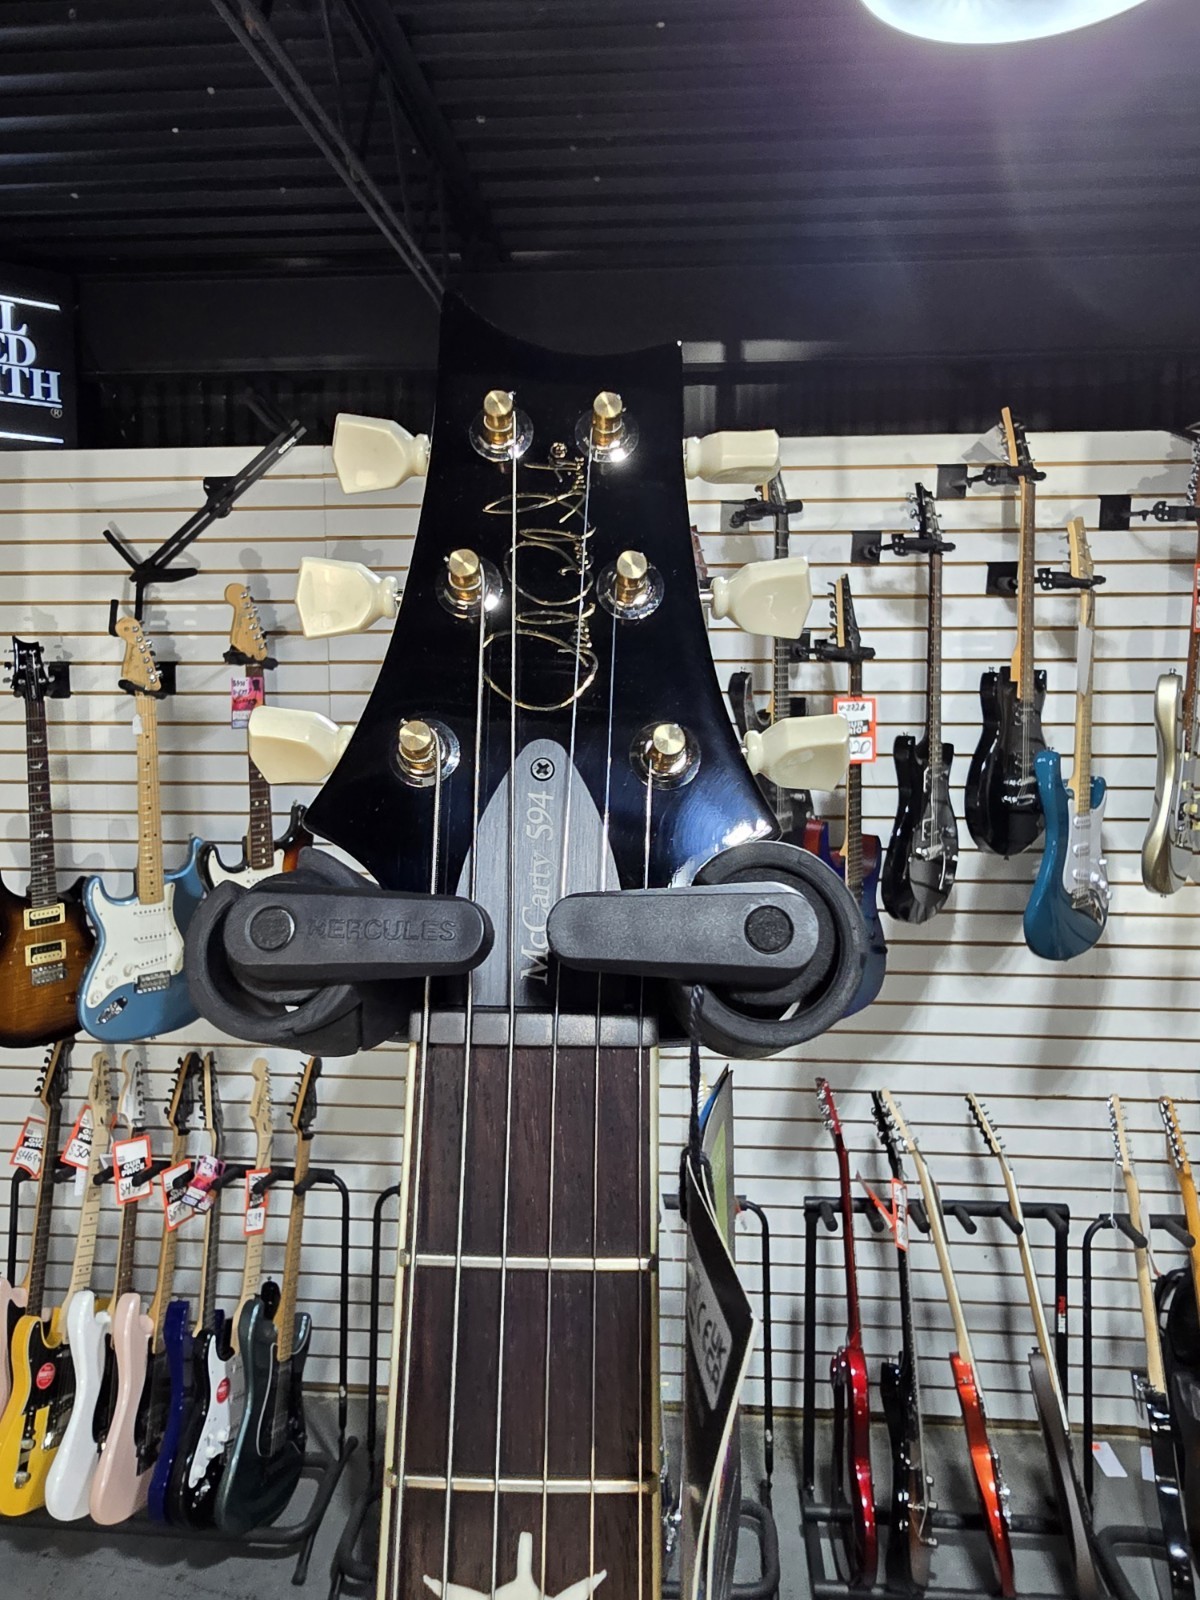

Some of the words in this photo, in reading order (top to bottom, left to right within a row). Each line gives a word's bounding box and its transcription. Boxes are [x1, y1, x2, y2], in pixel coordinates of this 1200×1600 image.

[0, 364, 62, 402] TH
[525, 790, 554, 841] 594
[306, 918, 457, 942] HERCULES
[520, 852, 557, 985] McCarty
